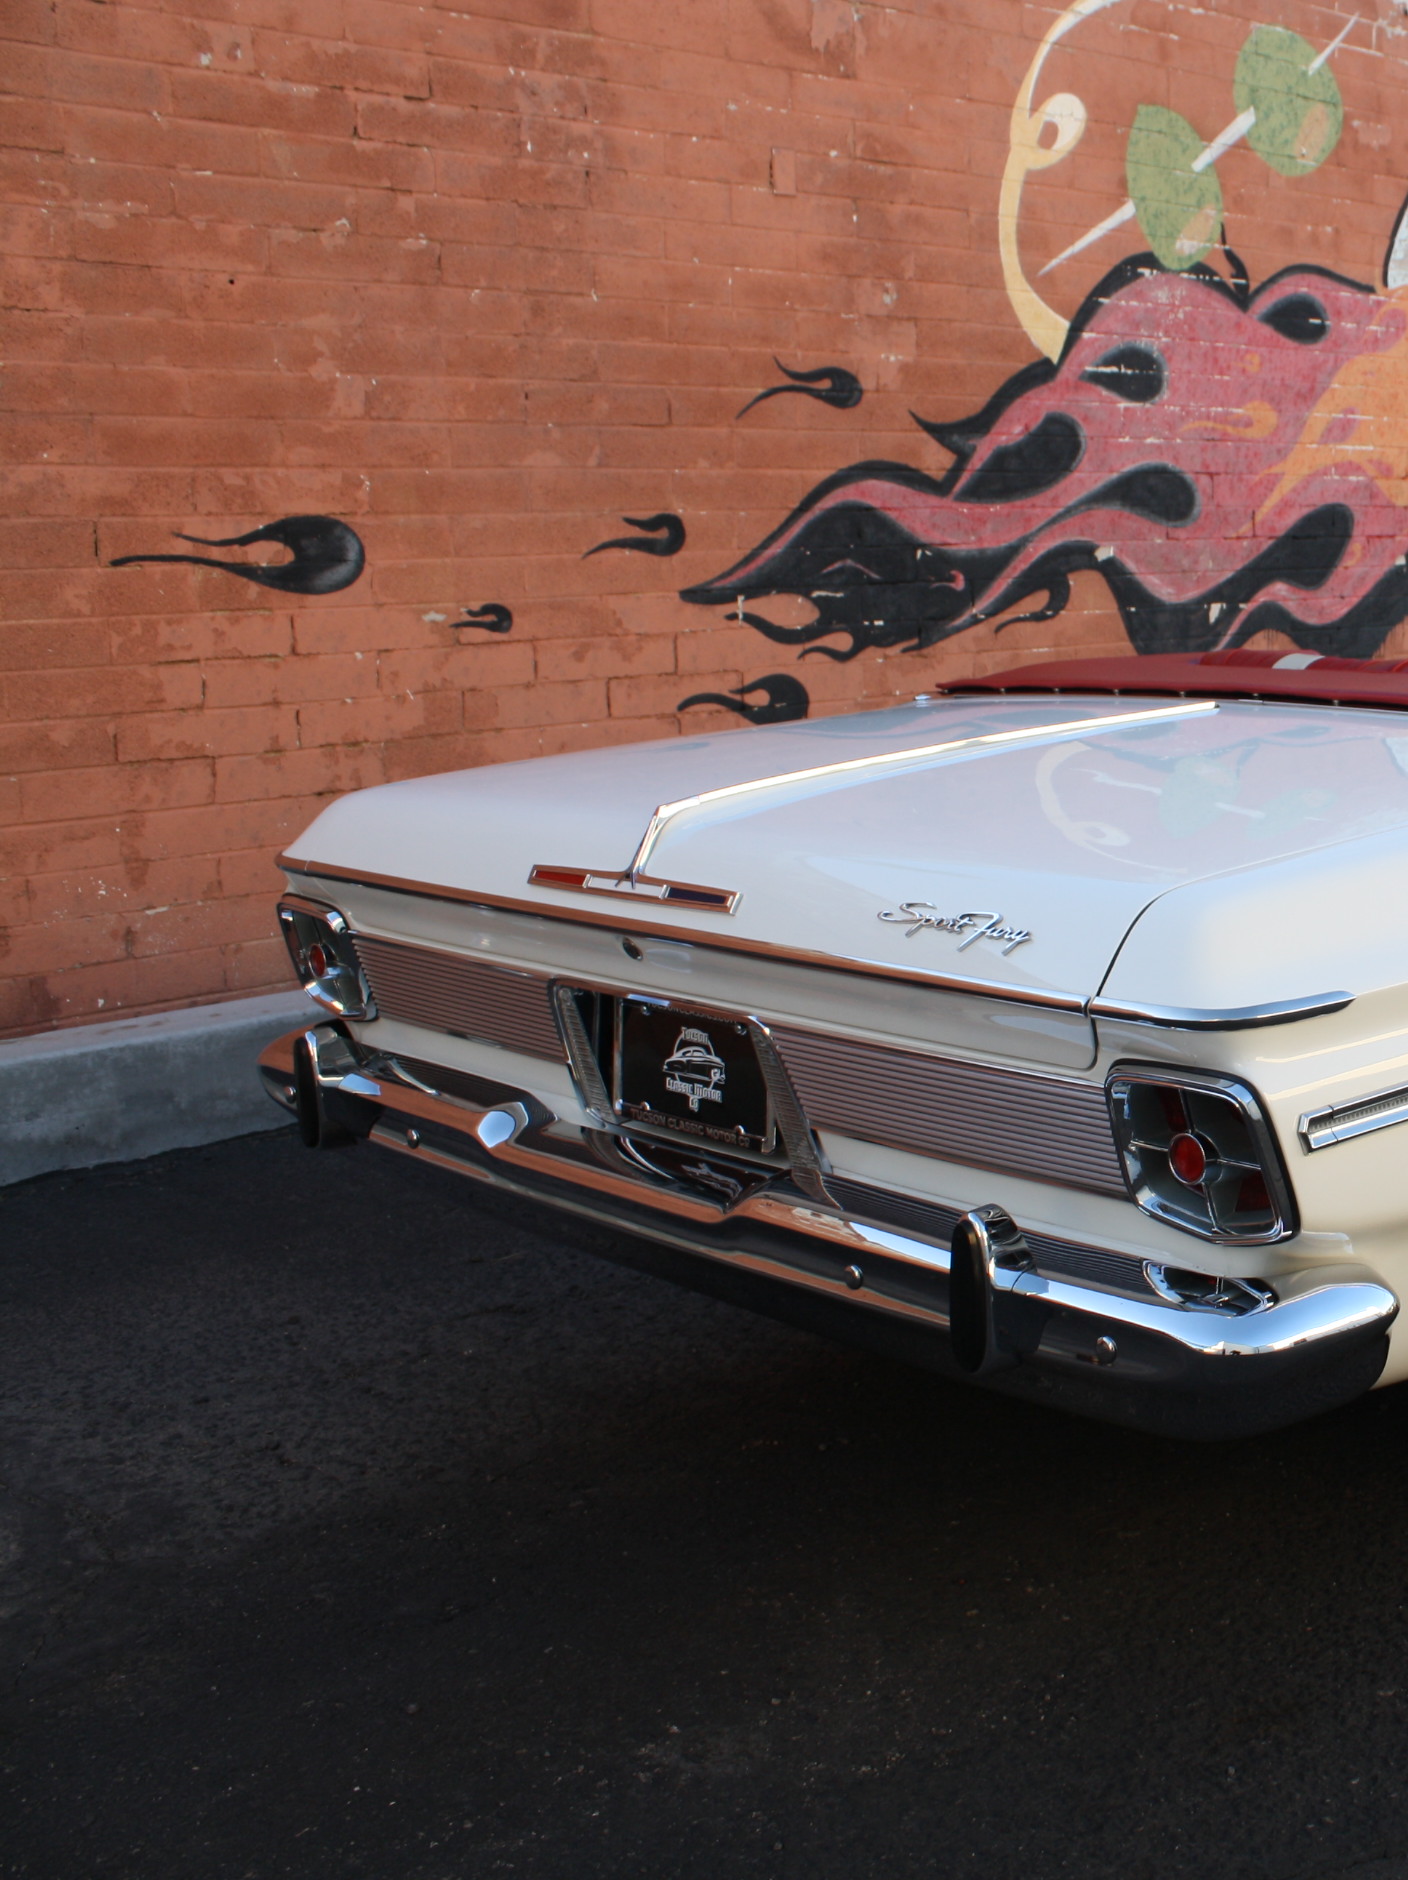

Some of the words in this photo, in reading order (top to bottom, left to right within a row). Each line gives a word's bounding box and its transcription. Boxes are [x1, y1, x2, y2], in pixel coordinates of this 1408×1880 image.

[877, 902, 975, 938] Sport
[956, 911, 1034, 957] Fury
[630, 1108, 666, 1126] TUCSON
[667, 1117, 705, 1136] CLASSIC
[705, 1127, 738, 1145] MOTOR
